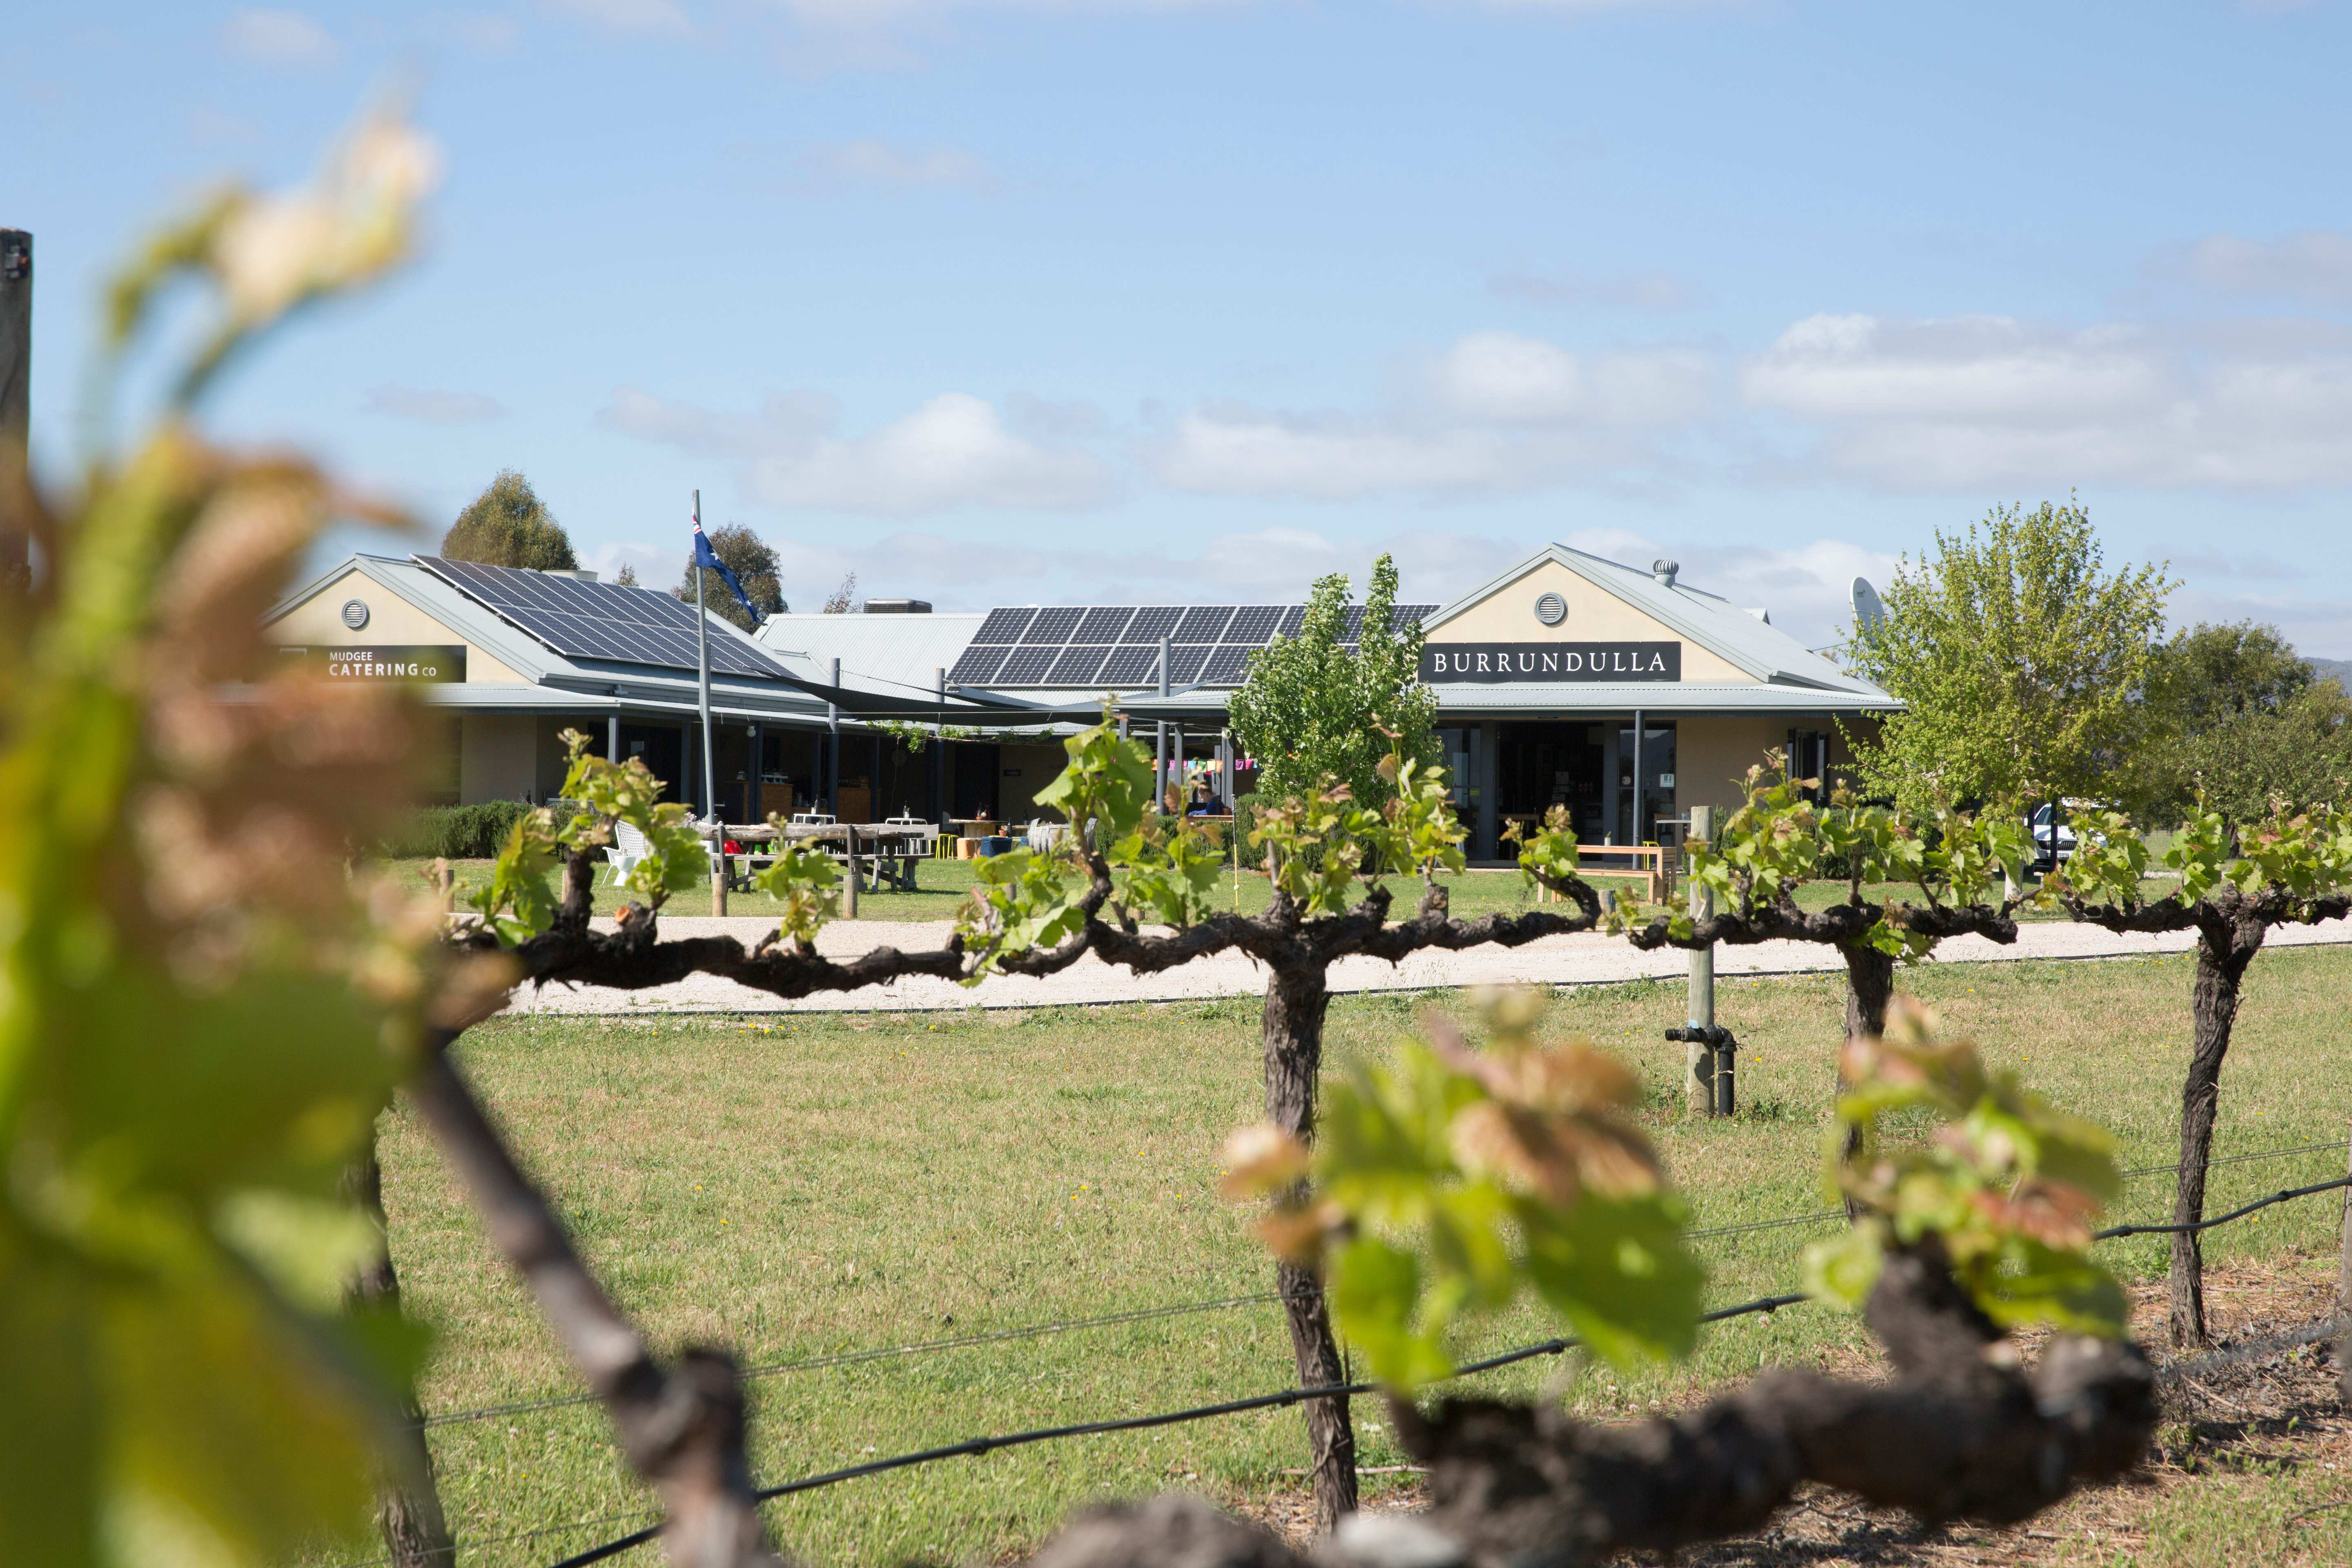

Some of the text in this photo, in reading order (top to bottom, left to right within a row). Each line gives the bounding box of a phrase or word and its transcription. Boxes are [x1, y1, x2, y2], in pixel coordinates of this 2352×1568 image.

[330, 652, 372, 661] MUDGEE
[1434, 653, 1666, 672] BURRUNDULLA
[329, 664, 437, 676] CATERING CO
